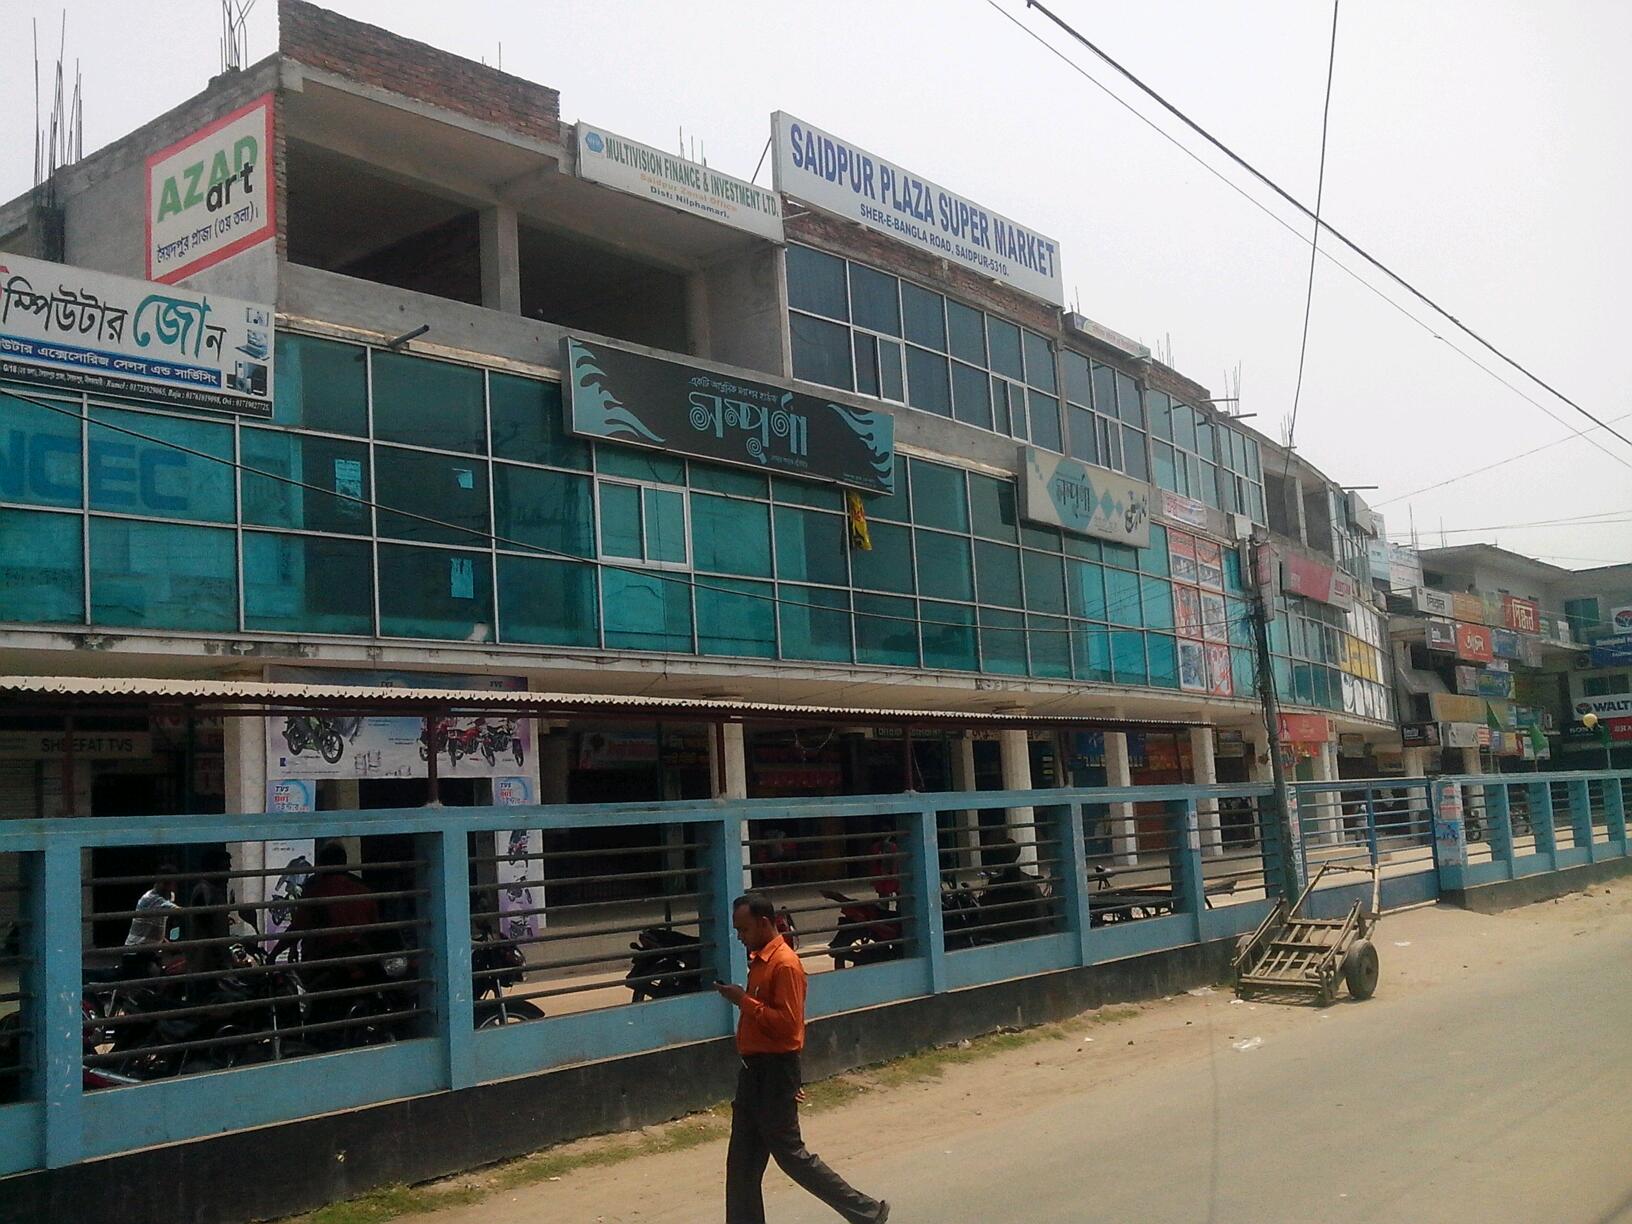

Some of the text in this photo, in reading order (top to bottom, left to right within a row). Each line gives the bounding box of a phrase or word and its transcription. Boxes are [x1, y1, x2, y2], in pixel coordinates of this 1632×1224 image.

[206, 161, 254, 213] art
[606, 137, 662, 177] MULTIVISION
[664, 158, 701, 190] FINANCE
[703, 172, 709, 191] &
[711, 174, 761, 211] INVESTMENT
[790, 124, 1055, 278] SAIDPUR PLAZA SUPER MARKET
[860, 204, 927, 244] SHER-E-BANGLA
[133, 294, 227, 361] জোন
[108, 738, 133, 752] TVS
